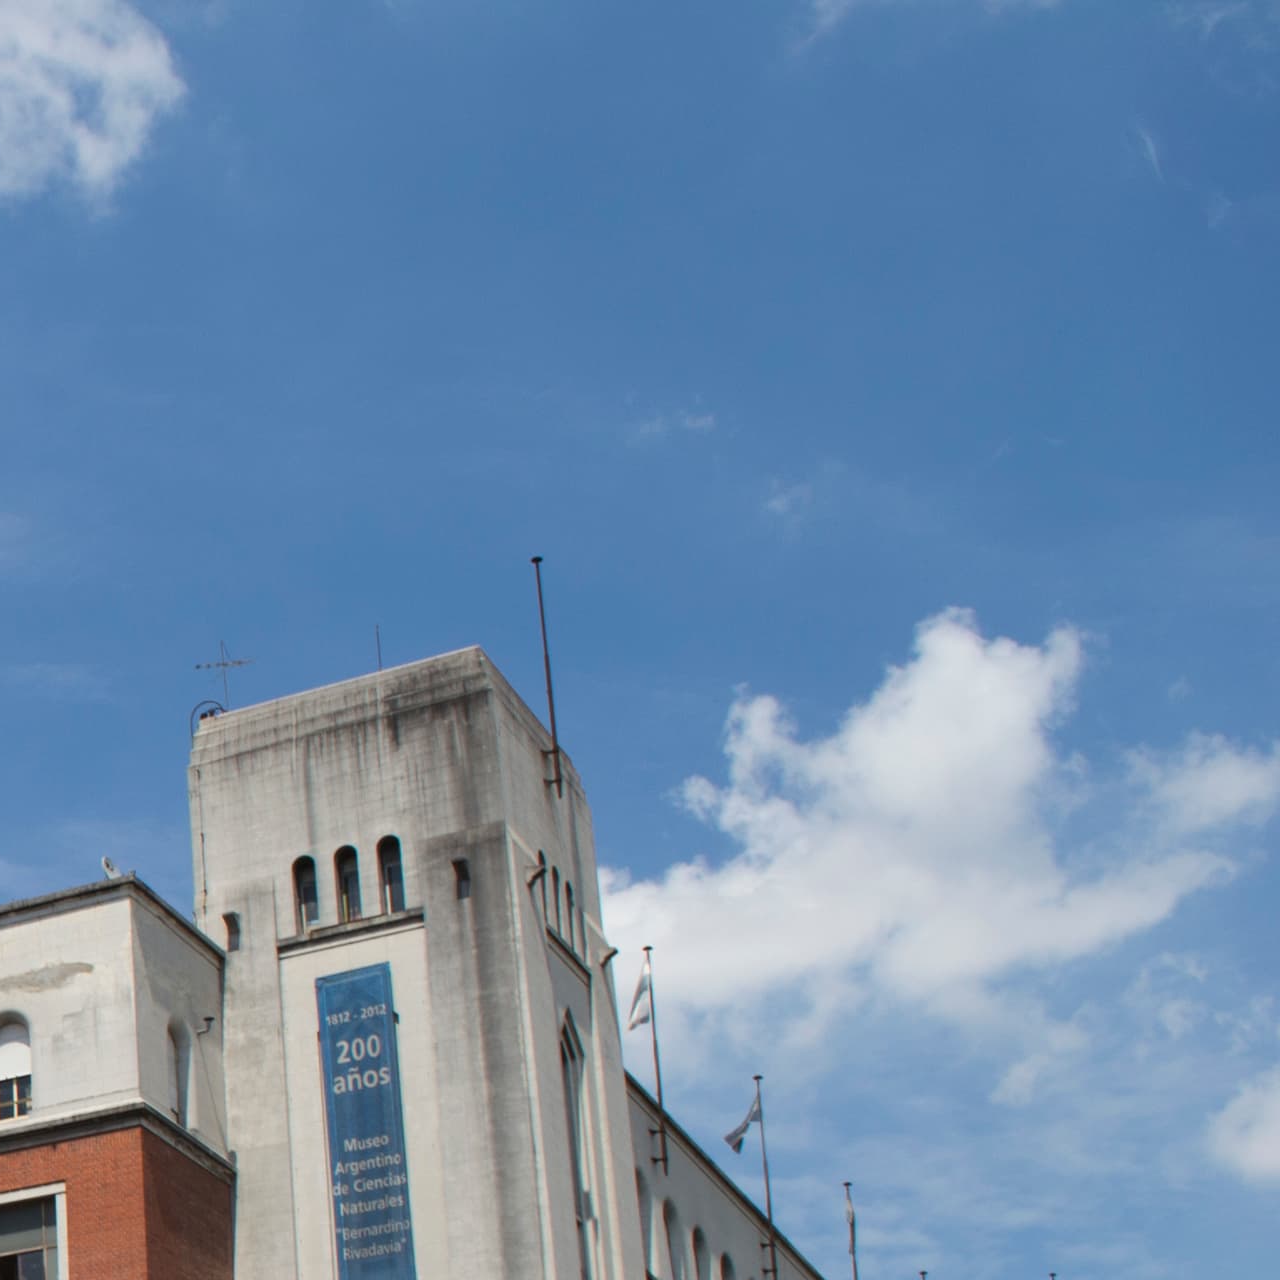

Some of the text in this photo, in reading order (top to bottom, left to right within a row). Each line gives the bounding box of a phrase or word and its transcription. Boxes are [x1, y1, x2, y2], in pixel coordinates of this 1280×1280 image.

[326, 1010, 351, 1026] 1812
[360, 1003, 388, 1019] 2012
[335, 1034, 381, 1065] 200
[333, 1065, 391, 1095] años
[343, 1134, 390, 1153] Museo
[334, 1151, 403, 1177] Argentino
[333, 1172, 408, 1197] de Ciencias
[340, 1194, 406, 1217] Naturales
